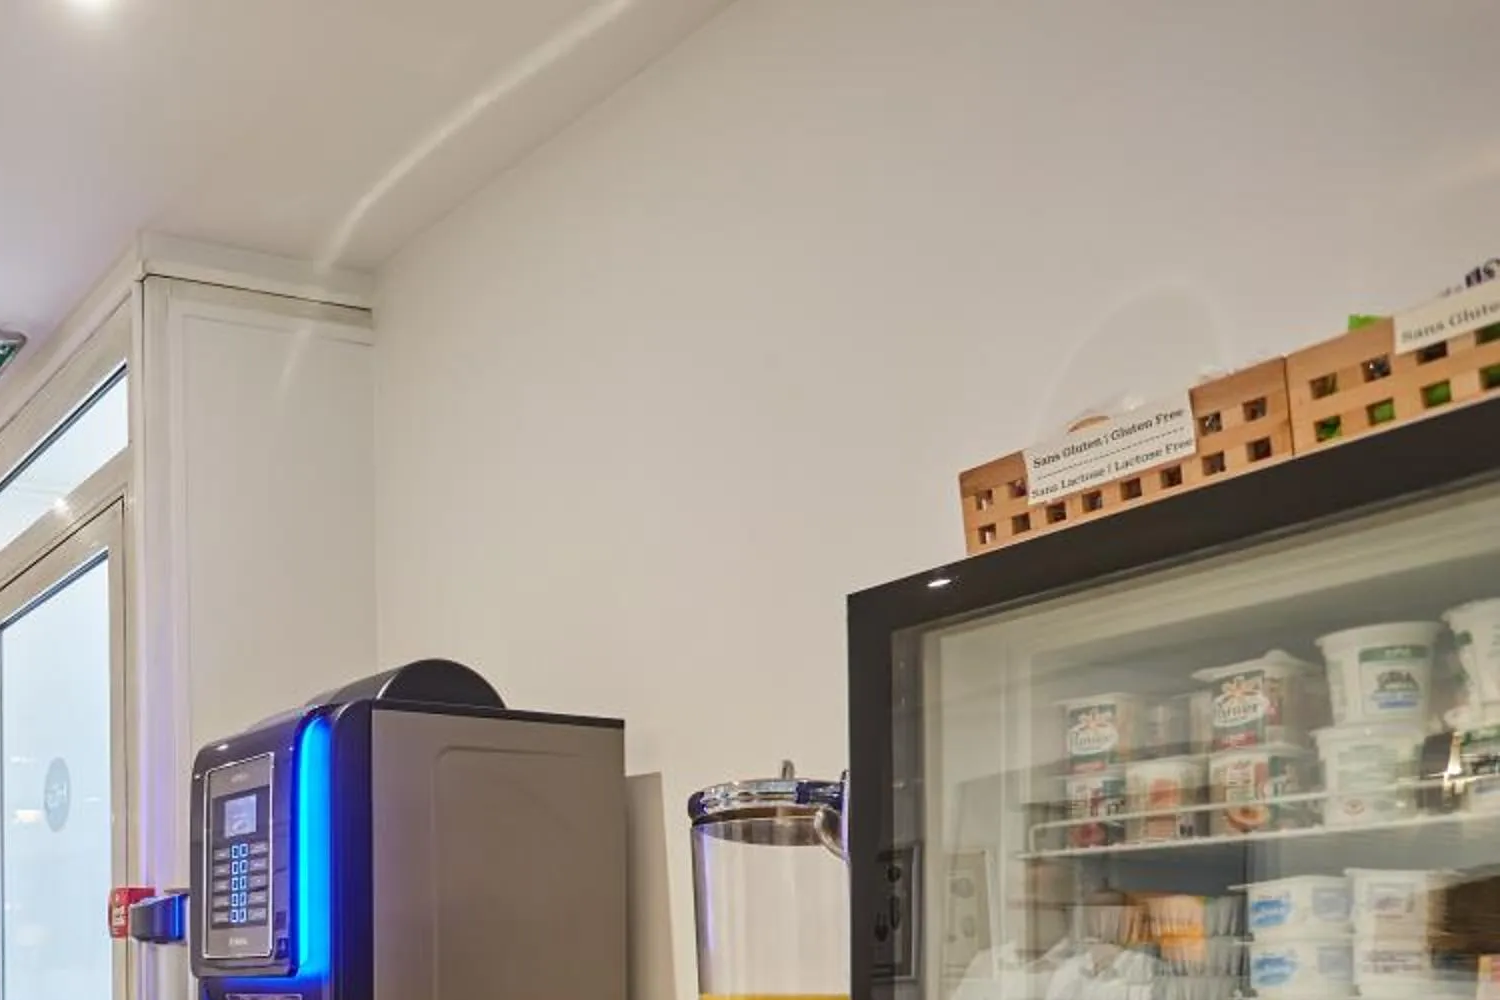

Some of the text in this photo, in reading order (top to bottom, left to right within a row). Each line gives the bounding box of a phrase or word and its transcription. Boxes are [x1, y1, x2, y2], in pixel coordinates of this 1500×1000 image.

[1033, 454, 1060, 468] Sans
[1062, 437, 1103, 457] Gluten
[1110, 419, 1153, 441] Gluten
[1155, 409, 1184, 425] Free
[1031, 483, 1059, 499] Sans
[1061, 467, 1106, 489] Lactose
[1114, 448, 1163, 472] Lactose
[1165, 439, 1193, 455] Free
